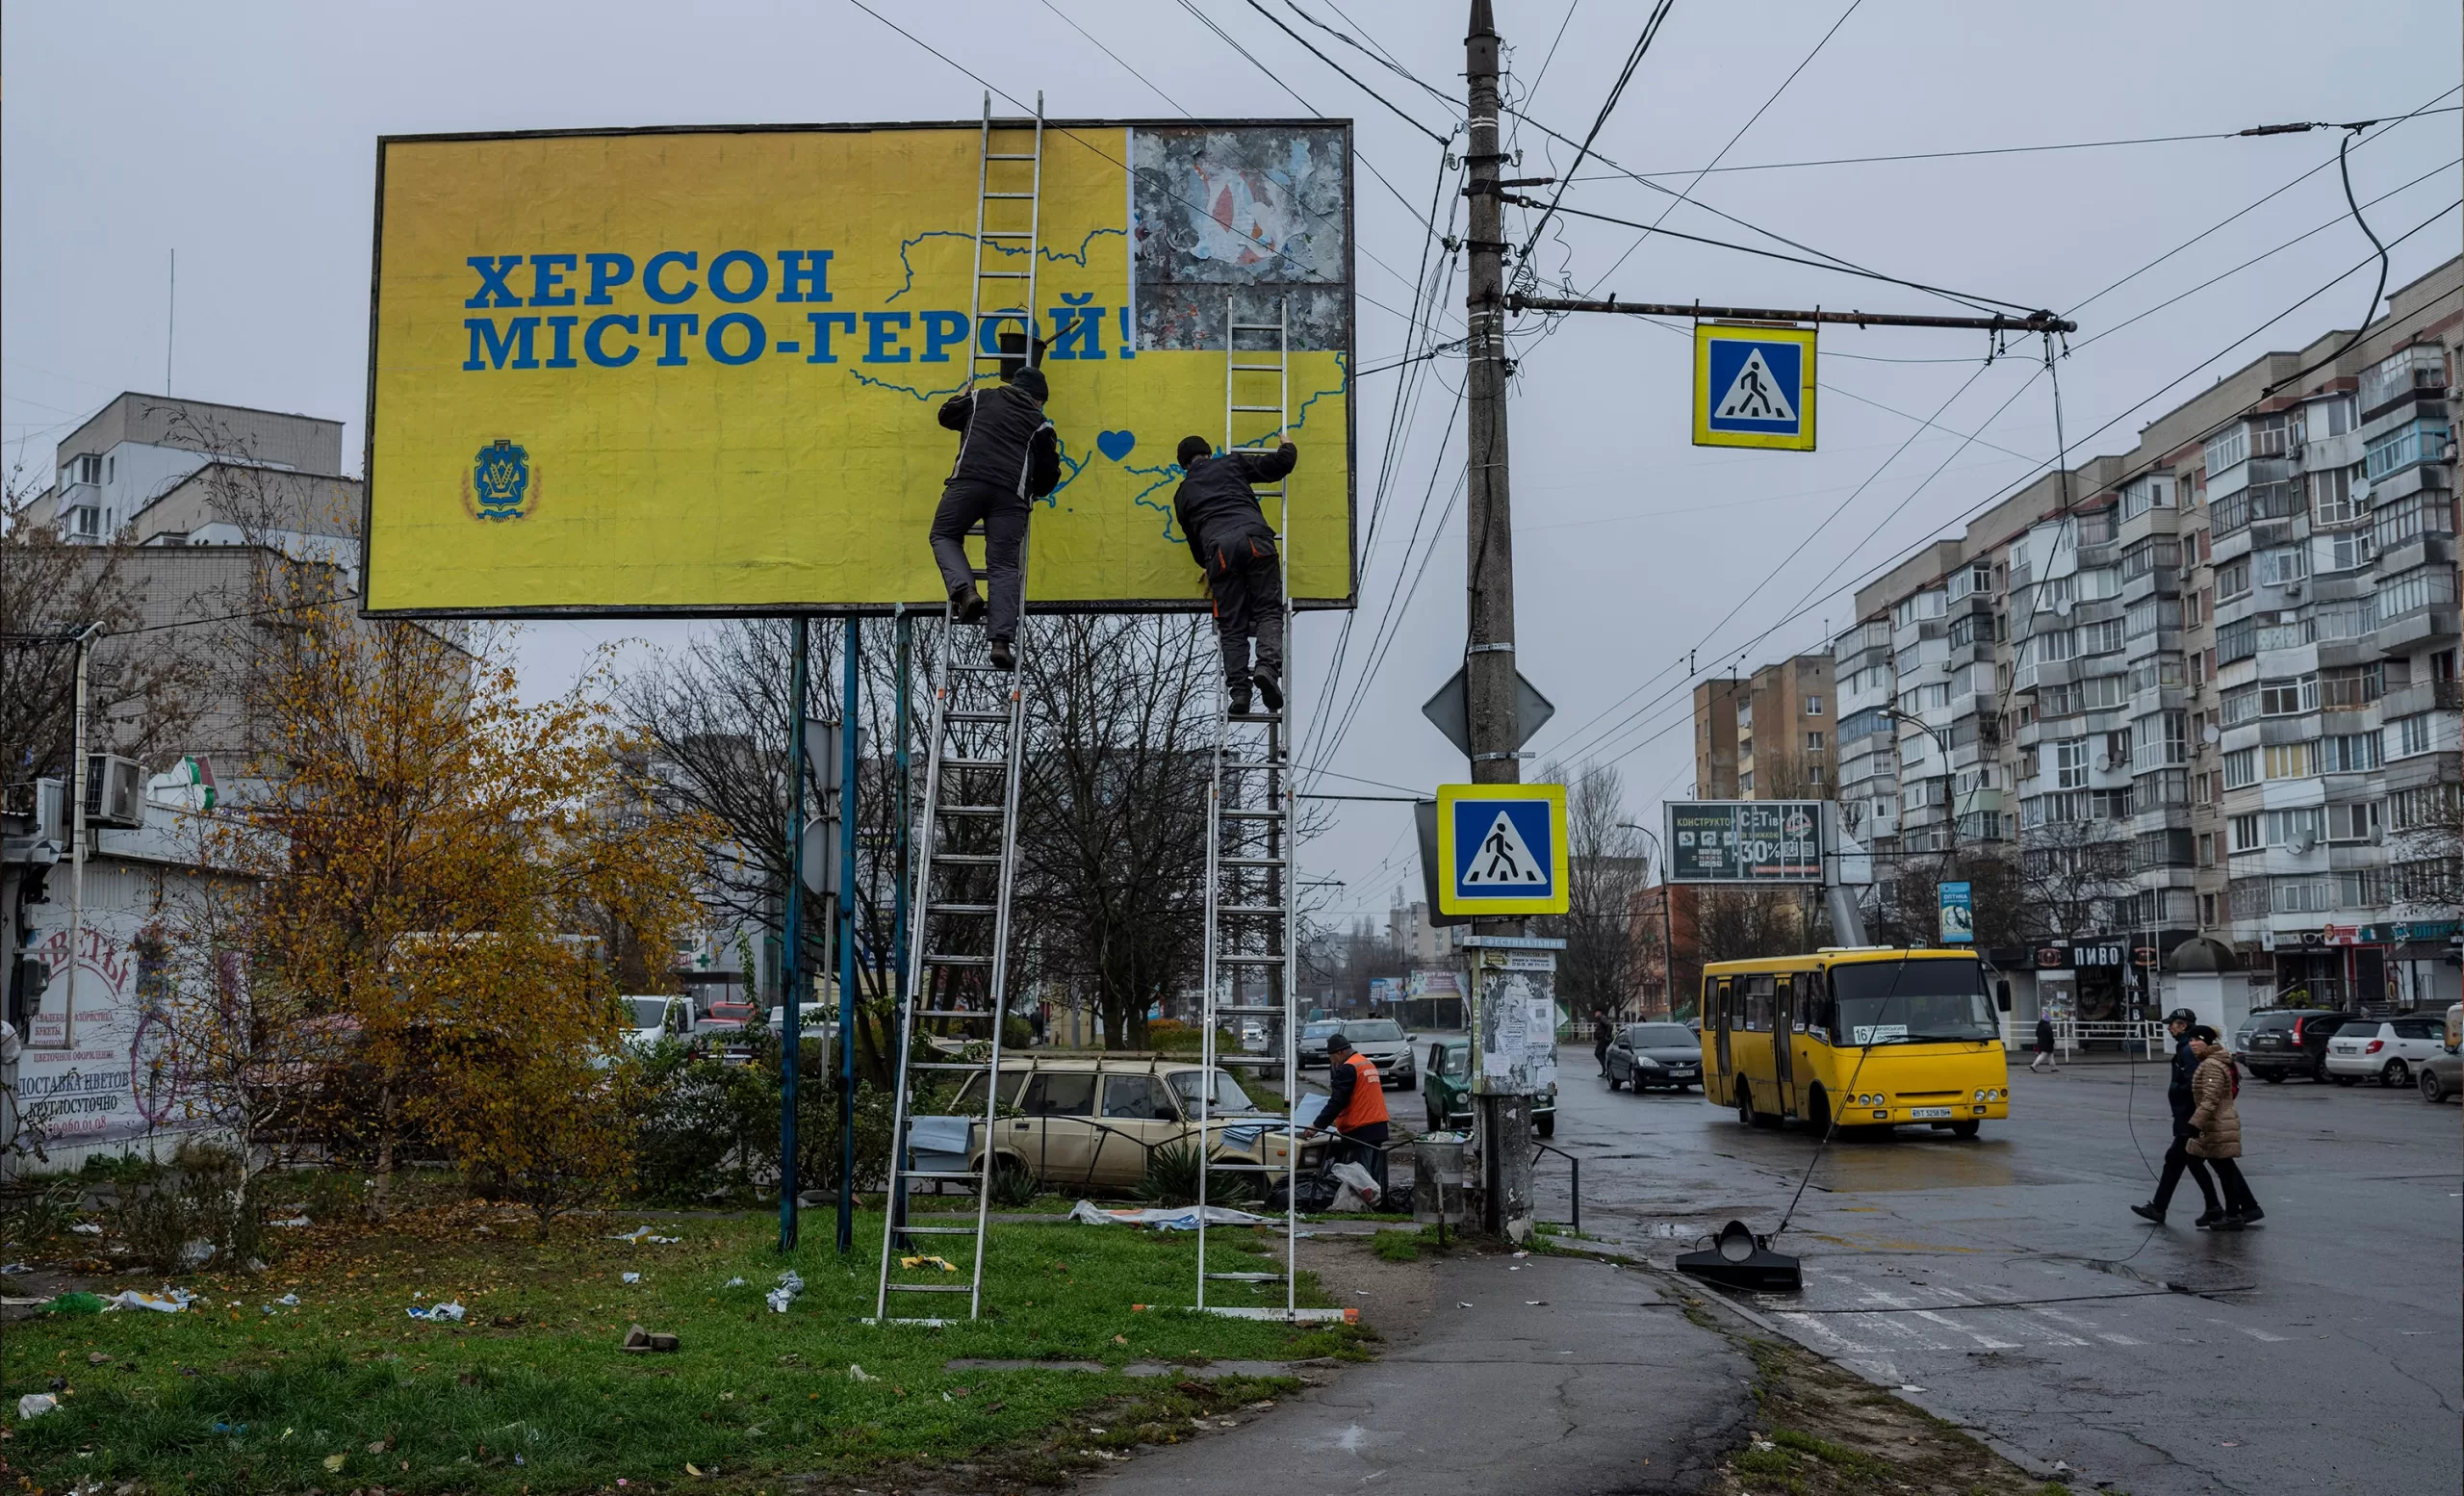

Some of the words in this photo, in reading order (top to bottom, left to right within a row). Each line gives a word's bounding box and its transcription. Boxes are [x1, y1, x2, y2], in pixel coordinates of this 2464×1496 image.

[465, 250, 834, 308] ХЕРСОН
[463, 293, 1136, 371] МІСТО-ГЕРОЙ!
[2074, 947, 2118, 966] ПИВО
[1856, 1028, 1867, 1041] 16
[34, 1051, 71, 1063] ЦВЕТОЧНОЕ
[17, 1074, 81, 1096] ДОСТАВКА
[84, 1071, 129, 1091] ЦВЕТОВ
[29, 1096, 117, 1117] КРУГЛОСУТОЧНО
[62, 1119, 80, 1134] 960
[83, 1119, 92, 1131] 01
[94, 1115, 107, 1129] 08
